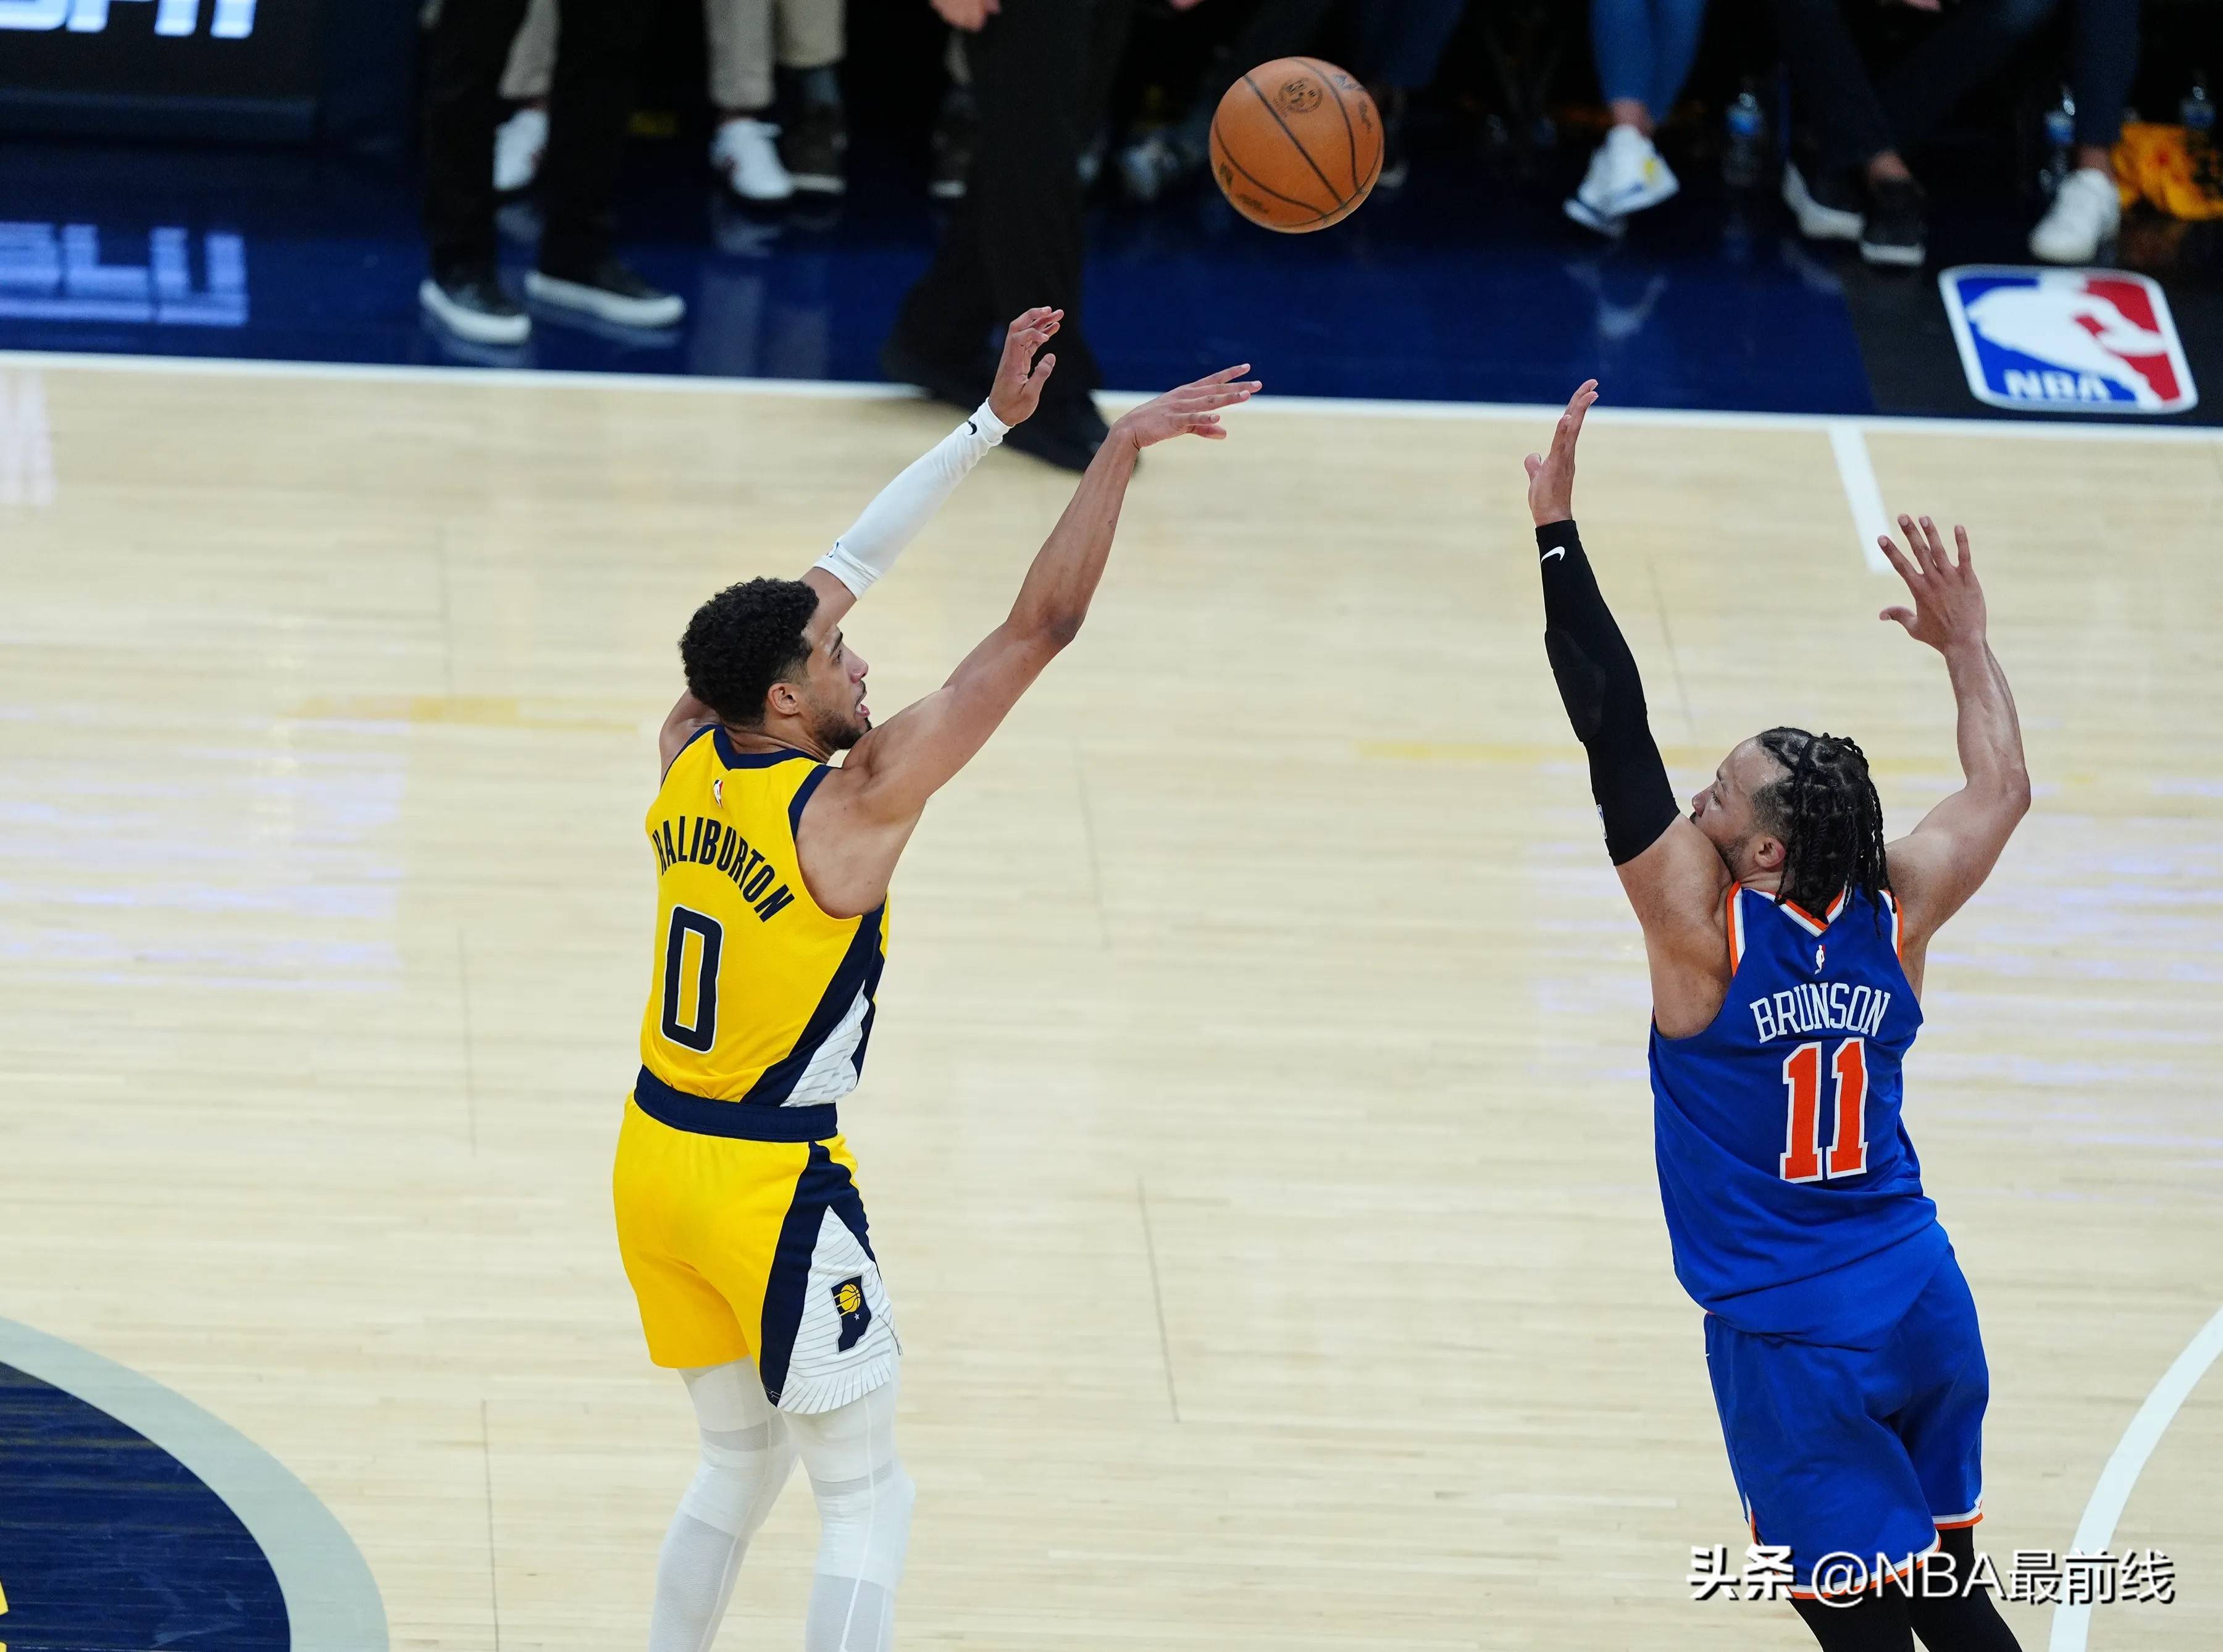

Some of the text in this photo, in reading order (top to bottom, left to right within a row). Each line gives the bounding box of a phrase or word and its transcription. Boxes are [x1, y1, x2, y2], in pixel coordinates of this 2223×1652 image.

[2004, 369, 2112, 401] NBA
[652, 815, 795, 923] HALIBURTON
[659, 903, 725, 1054] 0
[1749, 982, 1891, 1044] BRUNSON
[1779, 1036, 1869, 1184] 11
